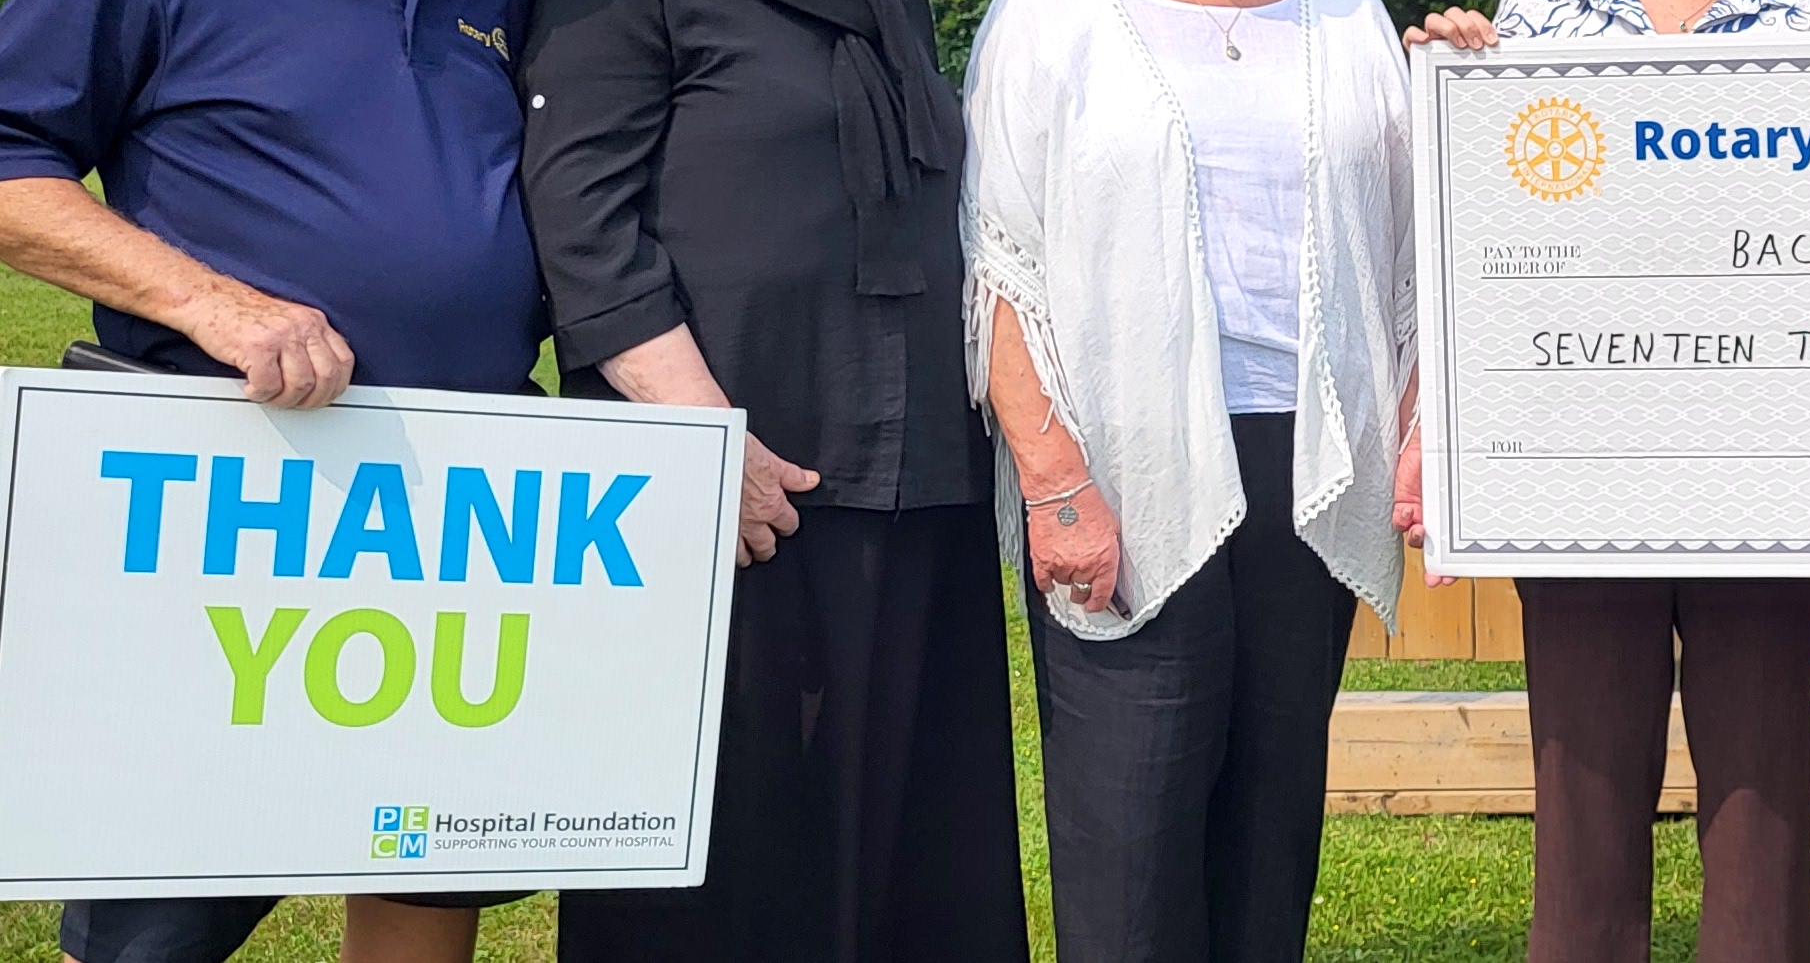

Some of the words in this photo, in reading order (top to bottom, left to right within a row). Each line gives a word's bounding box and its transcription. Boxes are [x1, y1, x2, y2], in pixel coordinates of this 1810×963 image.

[1484, 245, 1516, 259] PAY
[1520, 245, 1541, 258] TO
[1545, 245, 1581, 258] THE
[1482, 262, 1540, 274] ORDER
[1544, 261, 1566, 274] OF
[1532, 331, 1754, 366] SEVENTEEN
[1491, 441, 1523, 454] FOR
[100, 450, 652, 587] THANK
[204, 606, 531, 729] YOU
[435, 812, 536, 837] Hospital
[544, 812, 676, 832] Foundation
[434, 838, 518, 850] SUPPORTING
[521, 838, 557, 849] YOUR
[560, 837, 612, 848] COUNTY
[616, 836, 675, 847] HOSPITAL
